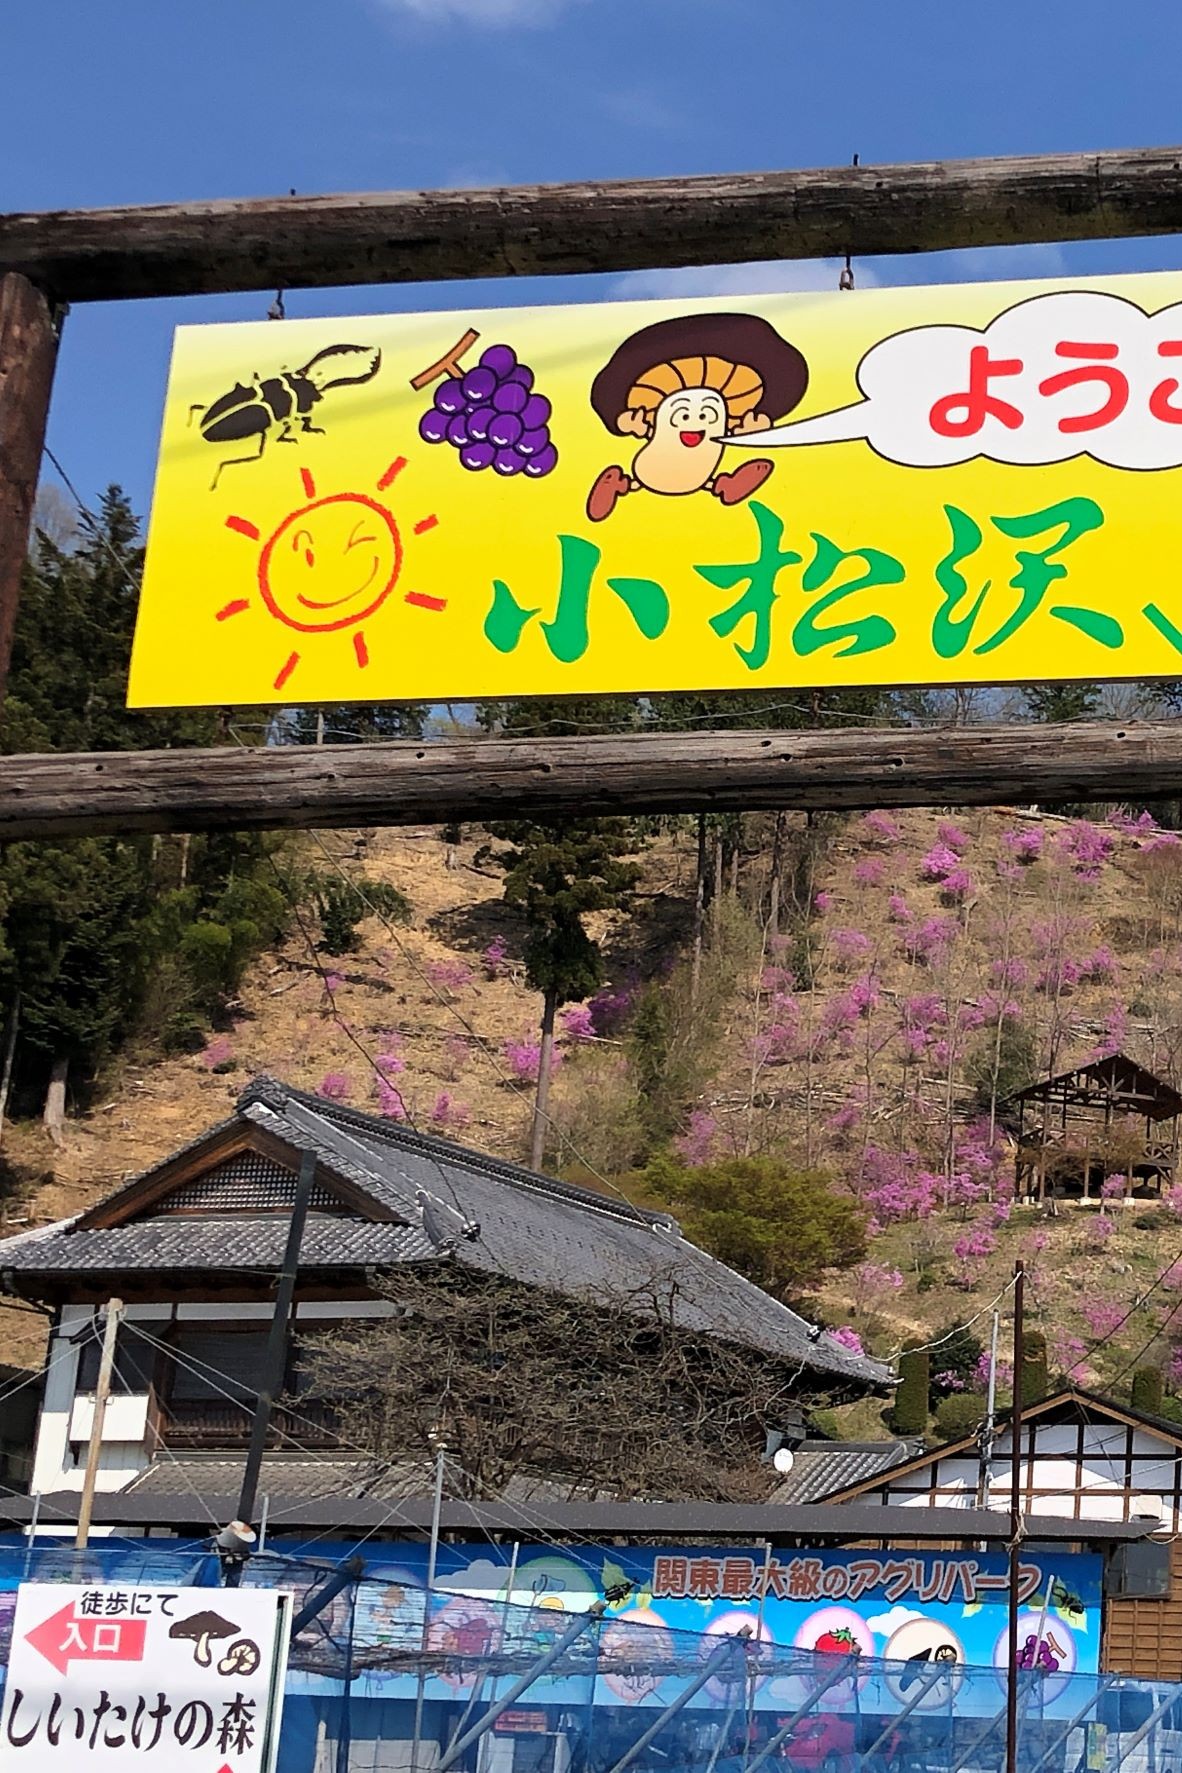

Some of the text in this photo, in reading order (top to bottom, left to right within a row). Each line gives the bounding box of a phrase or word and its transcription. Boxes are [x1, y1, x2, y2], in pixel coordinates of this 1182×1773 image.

[653, 1556, 1042, 1602] 関東最大級のアグリパーク
[80, 1590, 179, 1617] 徒歩にて
[58, 1621, 121, 1653] 入口
[7, 1688, 258, 1755] しいたけの森
